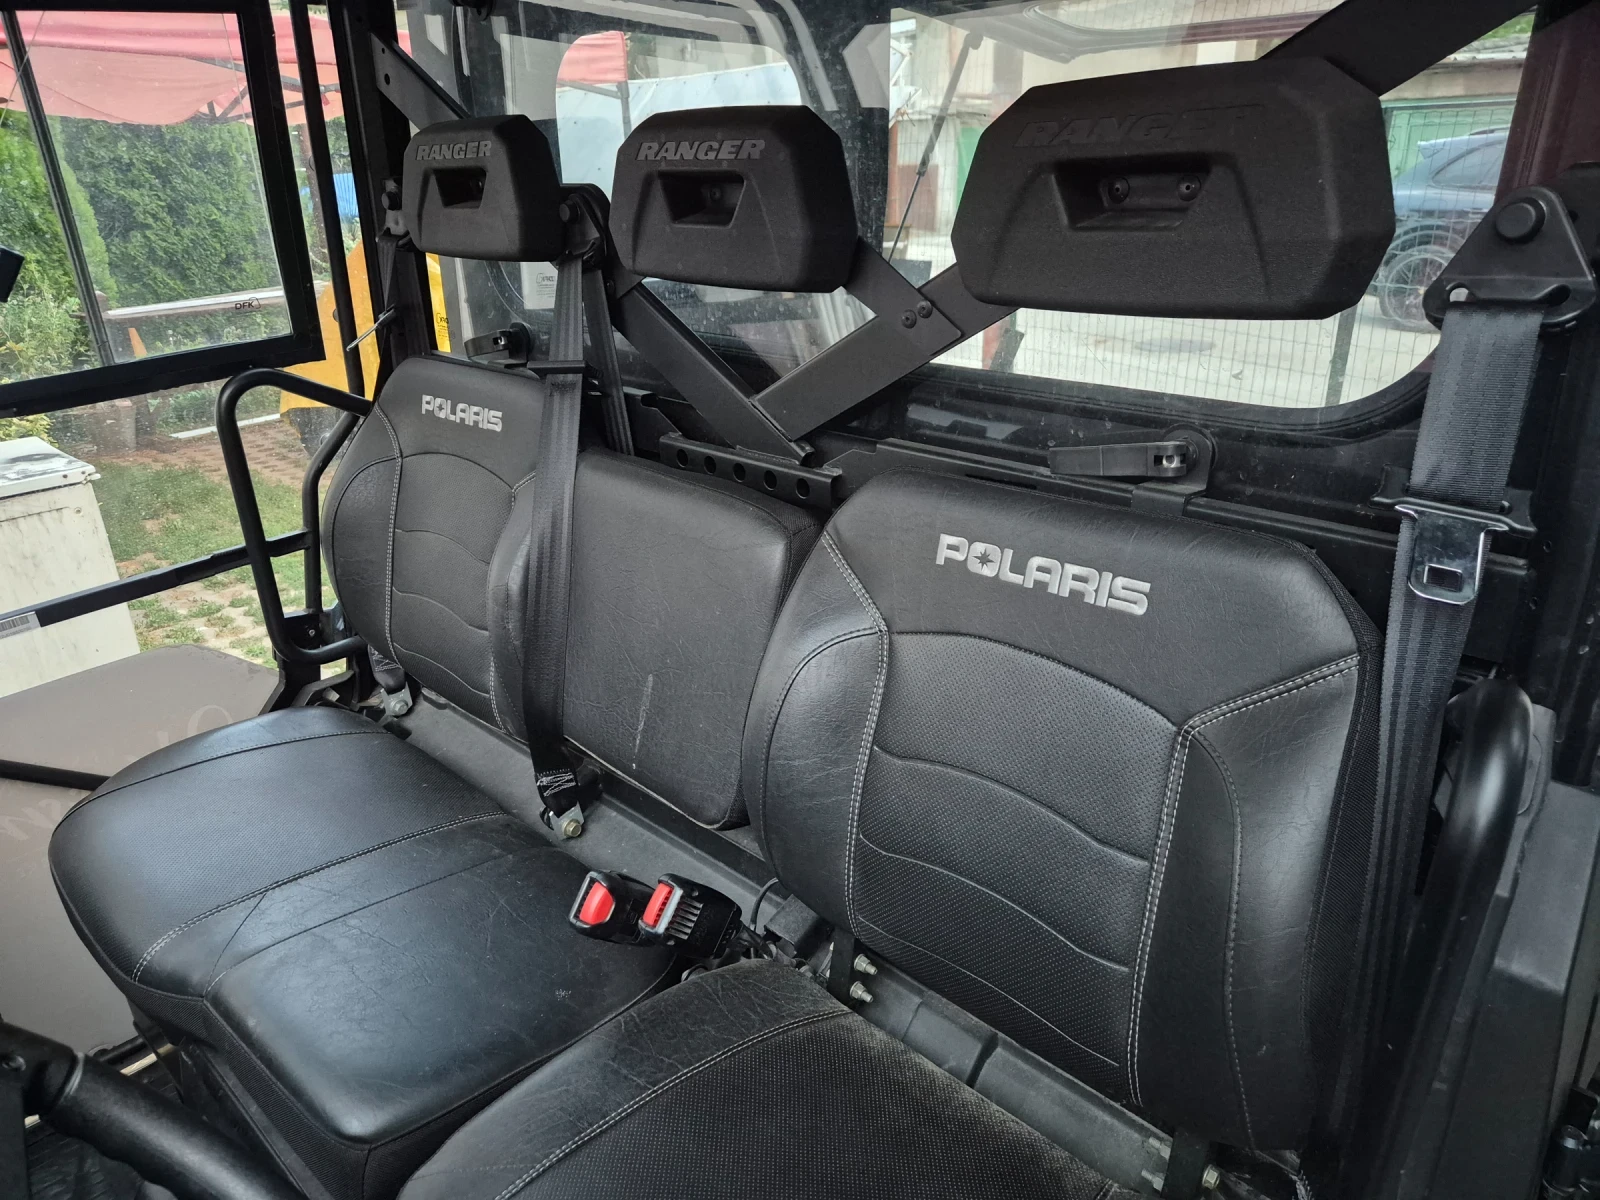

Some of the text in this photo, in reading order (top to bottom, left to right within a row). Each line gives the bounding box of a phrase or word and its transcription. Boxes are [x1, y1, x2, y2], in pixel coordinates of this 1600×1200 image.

[416, 140, 492, 161] RANGER
[636, 139, 766, 162] RANGER
[234, 300, 255, 310] DFK
[421, 394, 503, 433] POLARIS
[935, 533, 1152, 617] POLARIS
